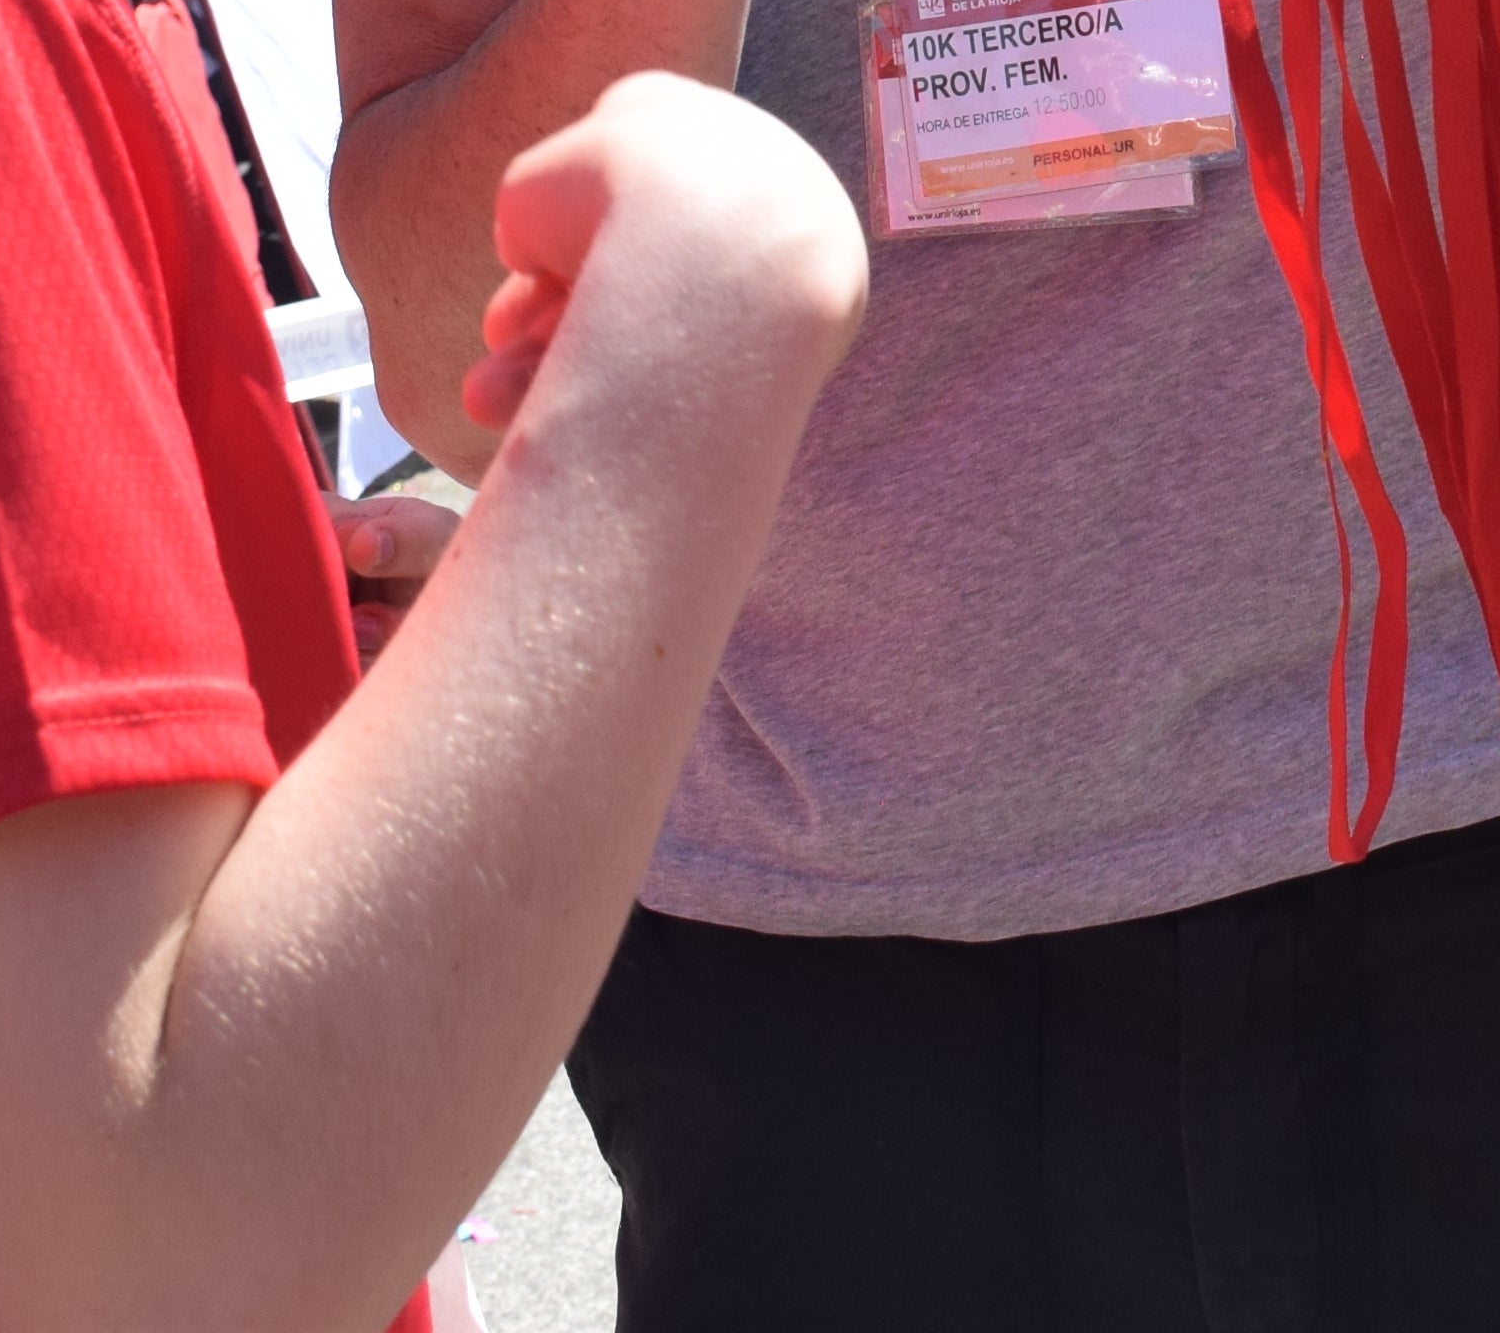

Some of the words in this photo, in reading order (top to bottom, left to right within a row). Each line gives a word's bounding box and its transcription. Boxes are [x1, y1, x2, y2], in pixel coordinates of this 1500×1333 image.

[951, 0, 968, 12] DE
[908, 32, 957, 63] 10K
[963, 7, 1123, 54] TERCERO/A
[912, 68, 996, 102] PROV.
[1004, 56, 1068, 89] FEM.
[916, 119, 951, 134] HORA
[954, 115, 970, 129] DE
[973, 106, 1030, 126] ENTREGA
[1033, 87, 1106, 116] 12:50:00
[1033, 143, 1111, 167] PERSONAL
[1114, 139, 1135, 153] UR
[907, 205, 981, 222] www.unirioja.es
